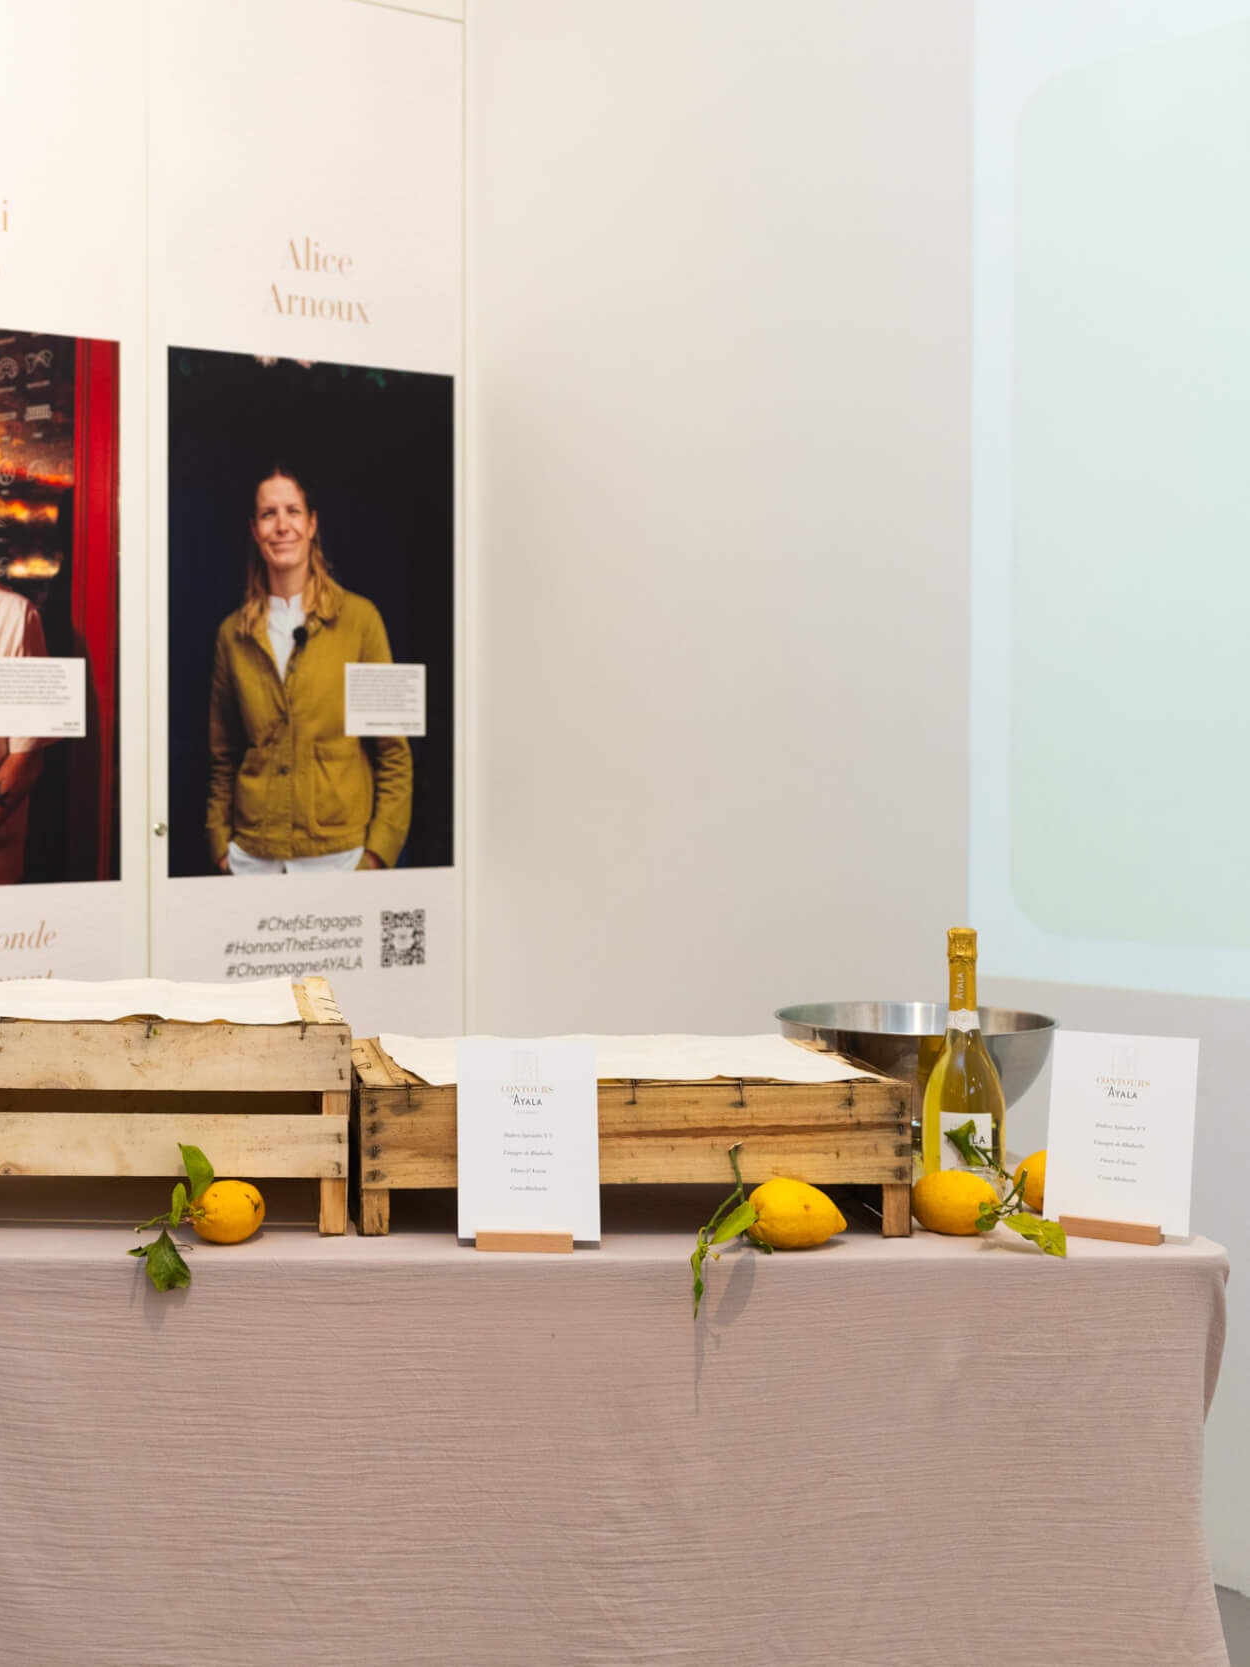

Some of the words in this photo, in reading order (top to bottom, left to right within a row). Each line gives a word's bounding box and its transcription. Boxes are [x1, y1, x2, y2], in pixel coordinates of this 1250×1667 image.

[279, 236, 354, 277] Alice
[262, 281, 371, 325] Arnoux
[257, 914, 363, 933] #ChefsEngages
[226, 955, 363, 978] #ChampagneAYALA
